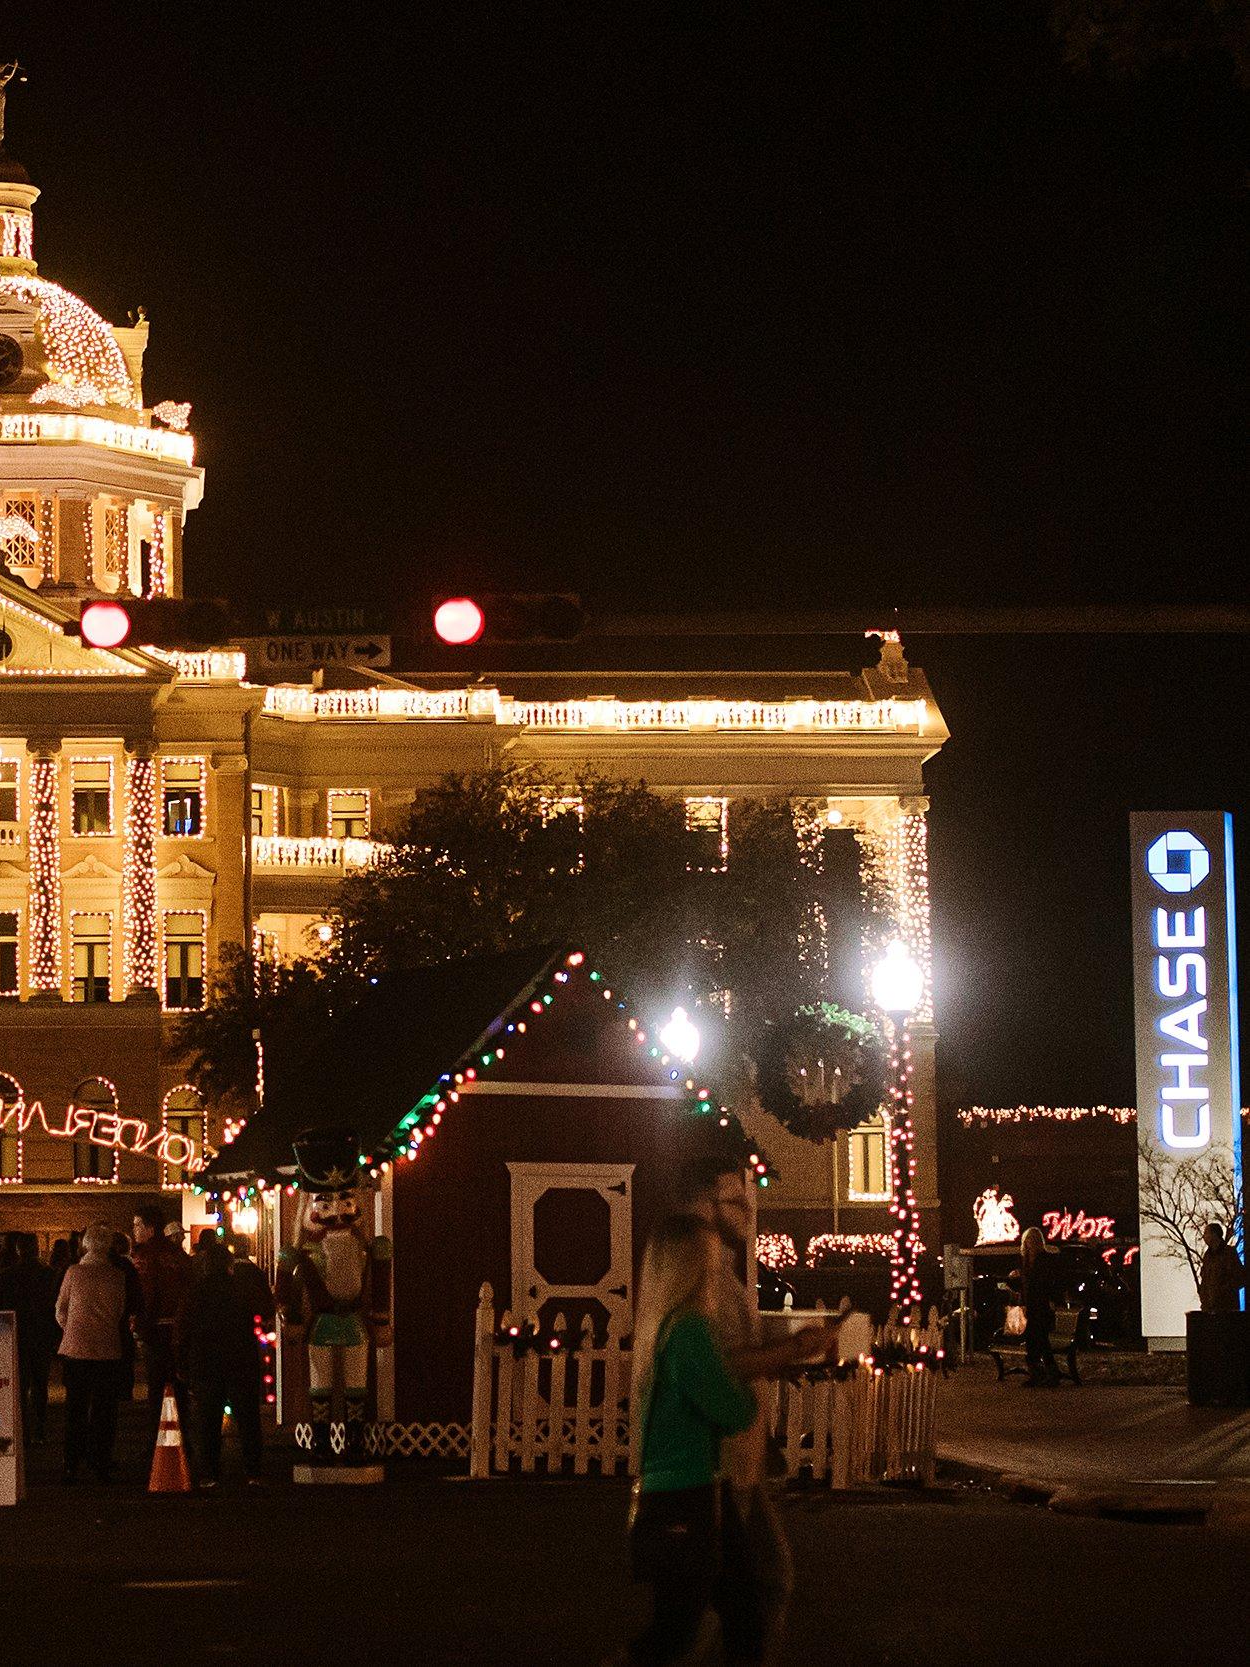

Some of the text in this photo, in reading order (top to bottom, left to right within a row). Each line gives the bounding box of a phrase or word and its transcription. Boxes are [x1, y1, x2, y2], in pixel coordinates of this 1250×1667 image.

[293, 608, 365, 628] AUSTIN
[266, 641, 350, 661] ONE WAY
[1157, 906, 1210, 1148] CHASE
